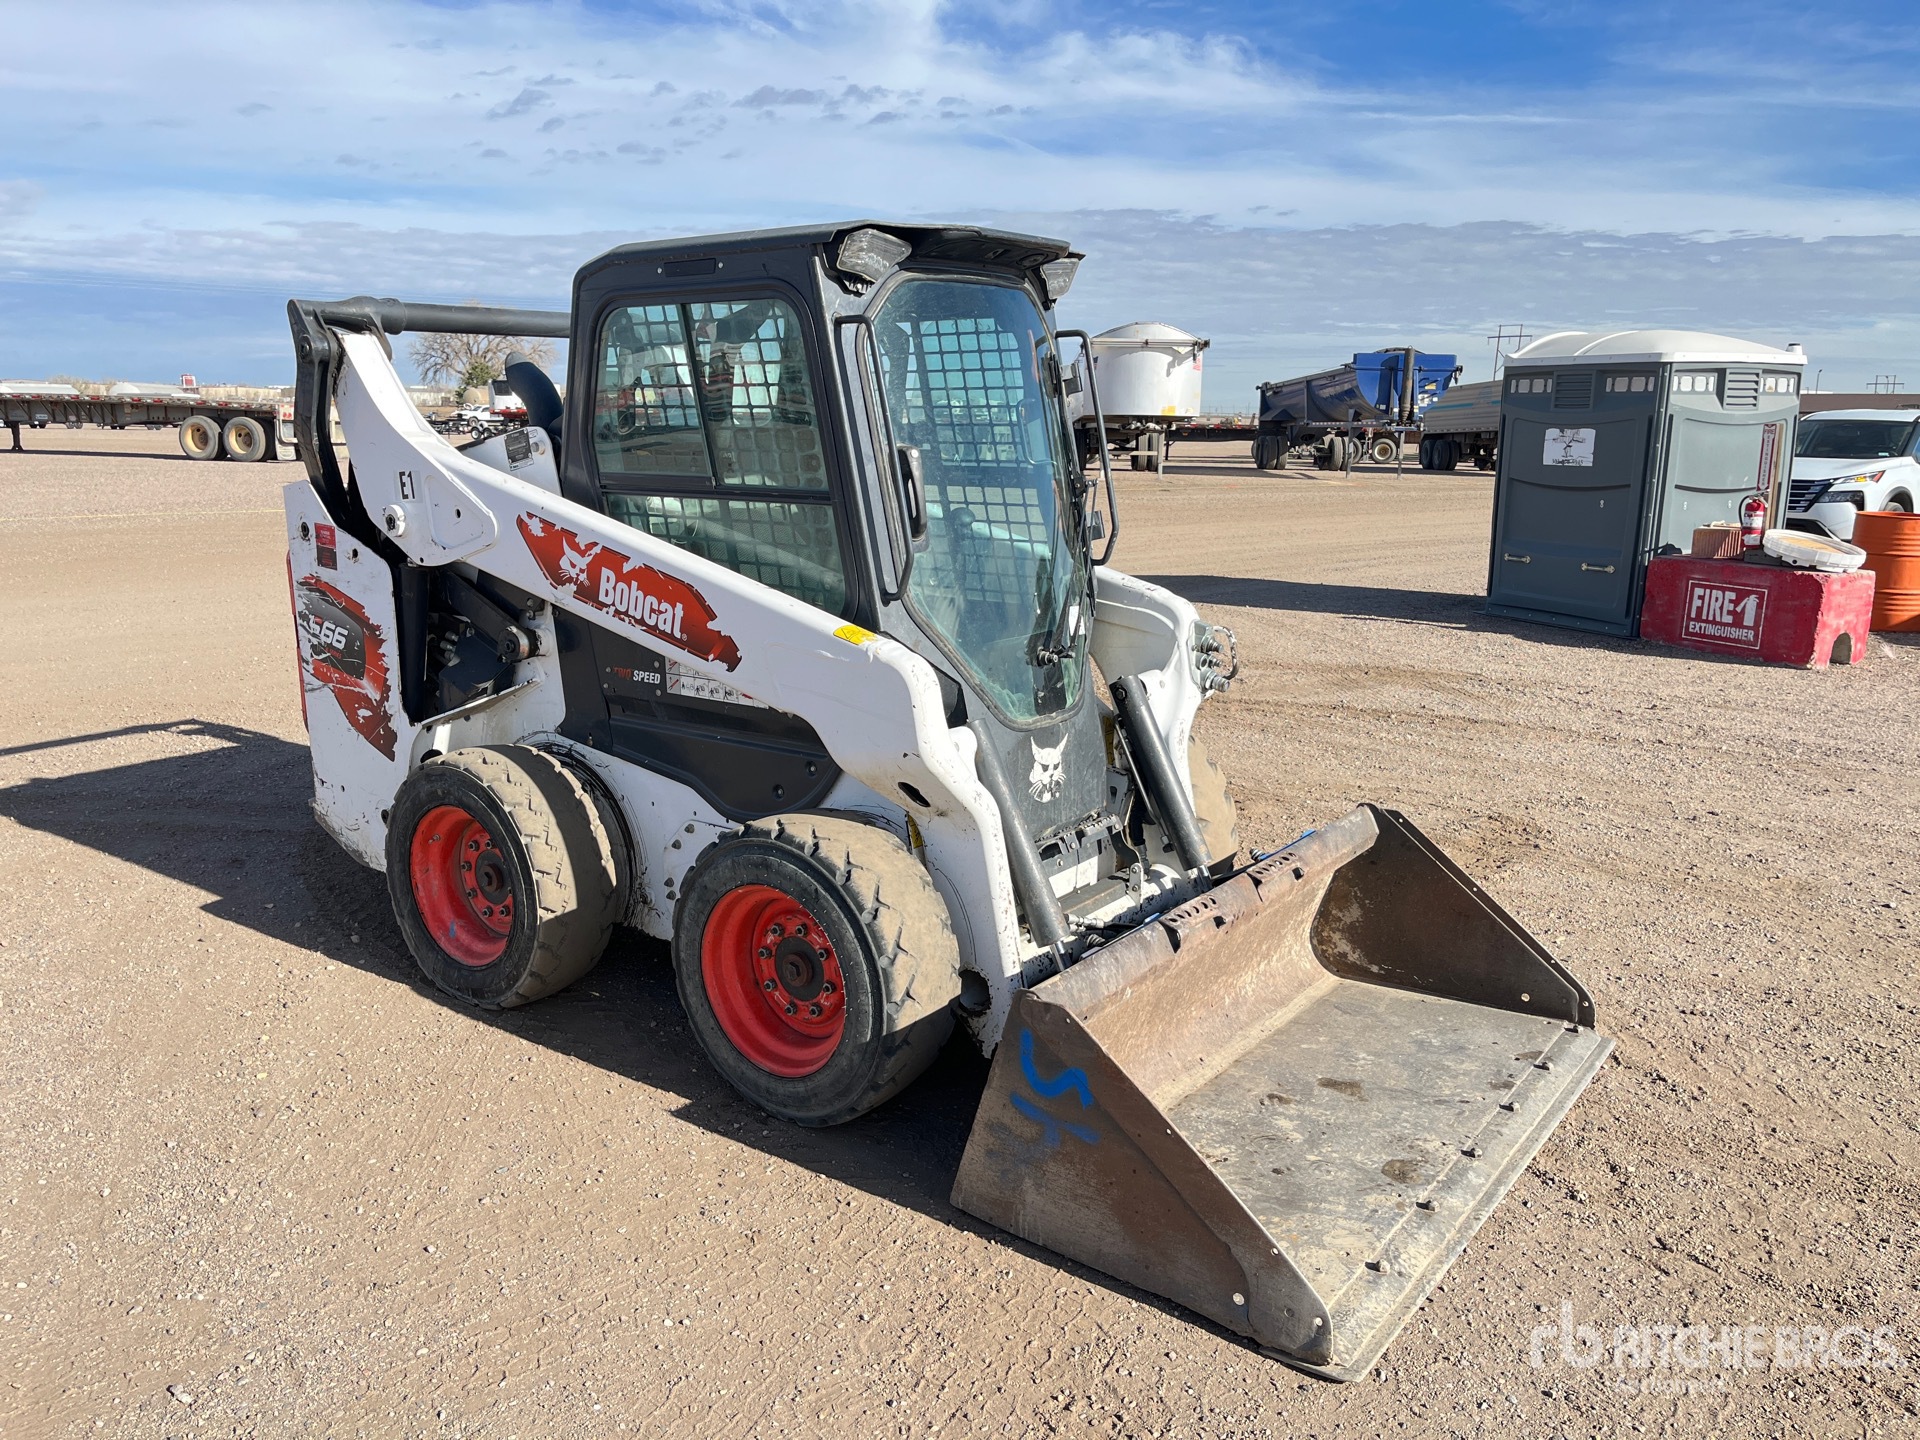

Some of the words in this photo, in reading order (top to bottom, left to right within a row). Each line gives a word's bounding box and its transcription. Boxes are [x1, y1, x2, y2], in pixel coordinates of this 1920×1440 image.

[399, 470, 415, 500] E1
[599, 567, 683, 639] Bobcat
[1691, 587, 1736, 623] FIRE
[1689, 621, 1754, 641] EXTINGUISHER
[633, 670, 661, 684] SPEED
